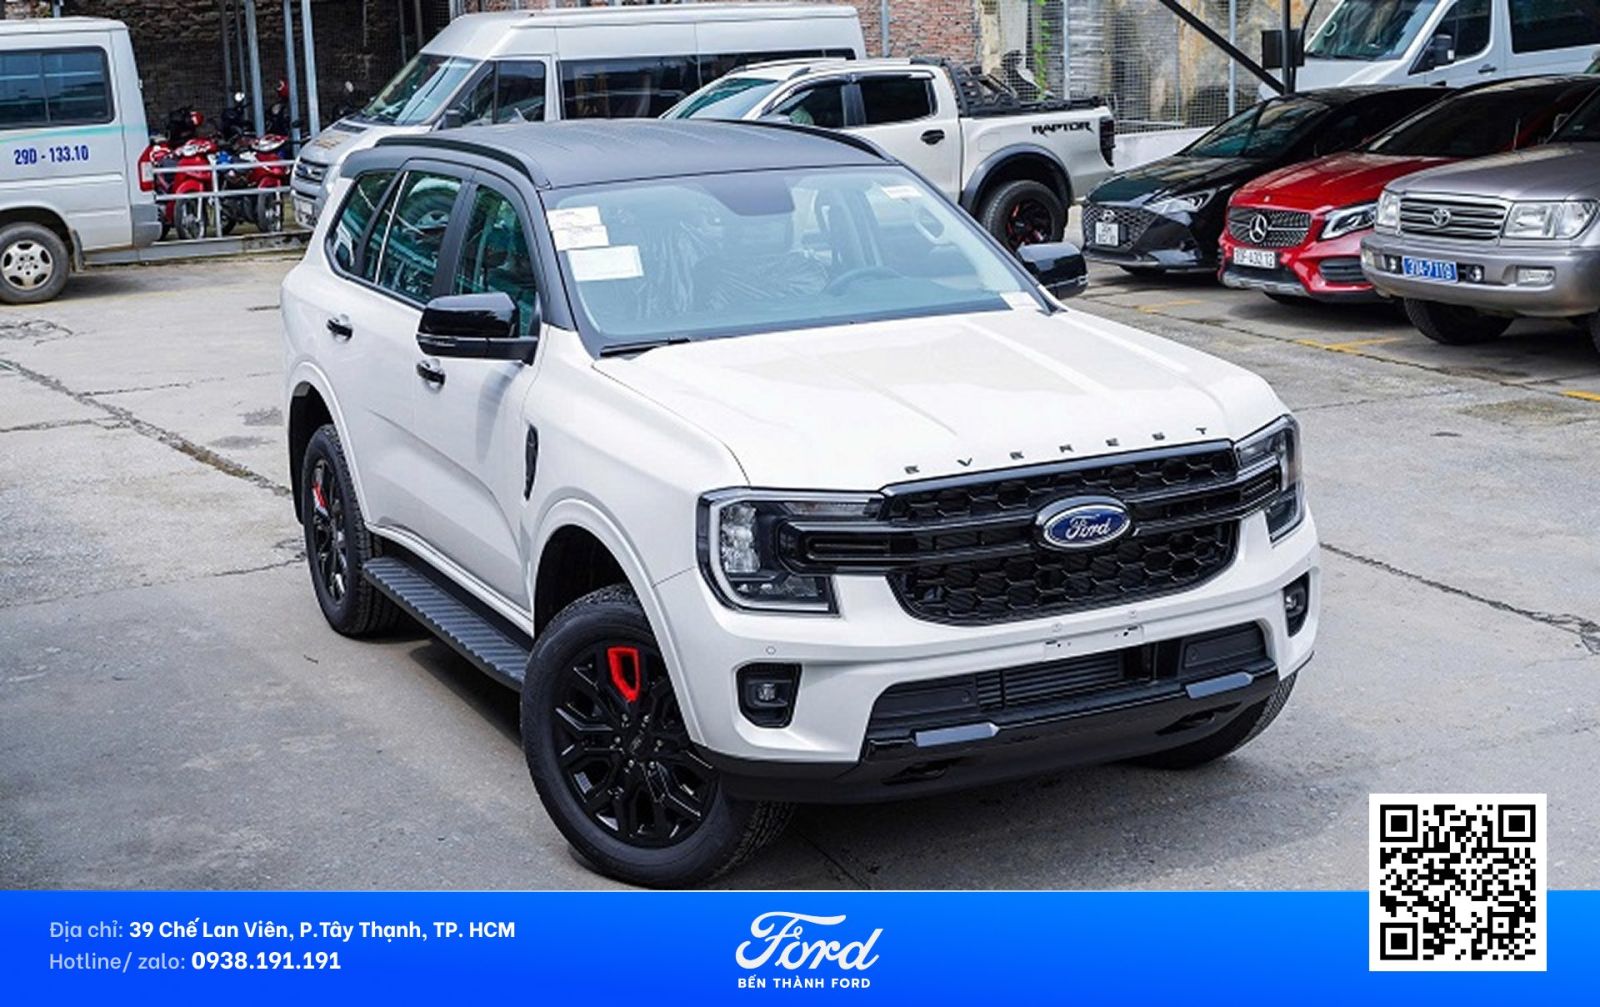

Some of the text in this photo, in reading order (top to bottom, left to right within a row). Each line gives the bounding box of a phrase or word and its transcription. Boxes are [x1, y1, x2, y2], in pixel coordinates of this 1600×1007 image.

[1032, 121, 1094, 137] RAPTOR
[14, 148, 37, 165] 29D
[49, 145, 89, 162] 133.10
[904, 427, 1207, 475] EVEREST
[1065, 514, 1112, 539] Ford
